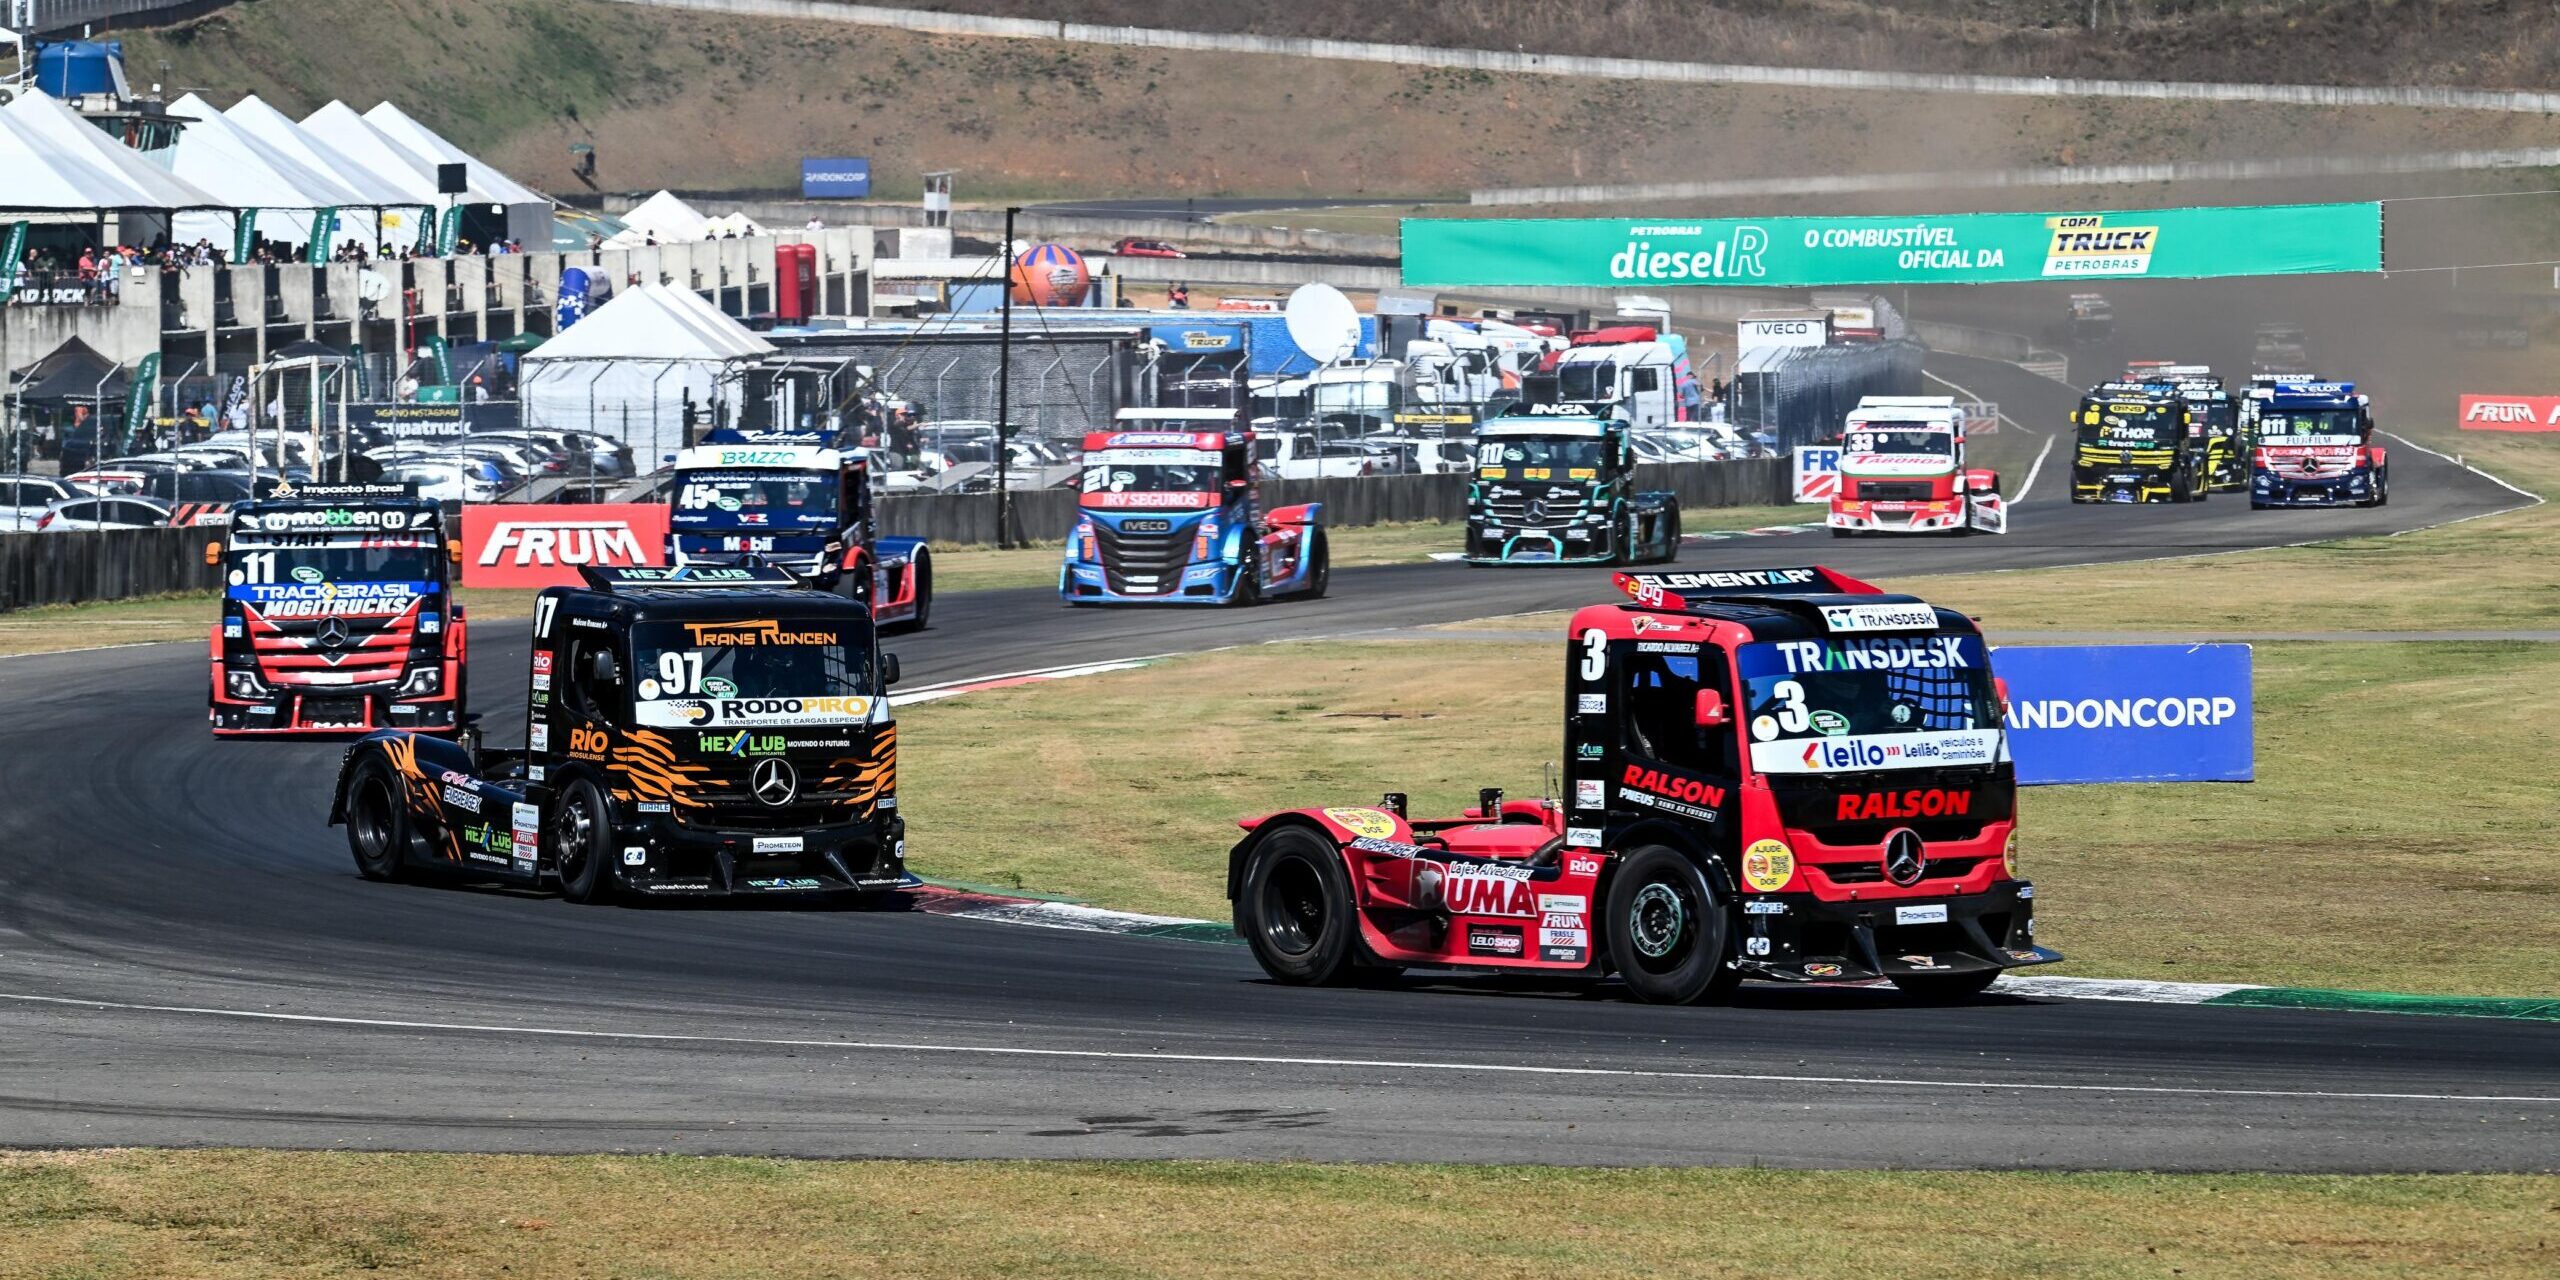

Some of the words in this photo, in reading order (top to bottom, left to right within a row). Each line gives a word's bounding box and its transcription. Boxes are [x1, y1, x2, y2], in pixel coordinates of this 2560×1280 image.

[805, 172, 866, 183] RANDONCORP
[2060, 218, 2098, 227] COPA
[1630, 226, 1702, 236] PETROBRAS
[1804, 229, 1819, 248] O
[1823, 224, 1958, 248] COMBUSTÍVEL
[2058, 231, 2151, 251] TRUCK
[1899, 249, 1971, 269] OFICIAL
[1976, 248, 2004, 267] DA
[2055, 259, 2139, 270] PETROBRAS
[1757, 324, 1807, 335] IVECO
[2466, 402, 2536, 423] FRUM
[2112, 428, 2155, 439] THOR
[1851, 433, 1874, 451] 33
[1083, 465, 1109, 493] 21
[303, 486, 363, 495] Impacto
[366, 484, 405, 493] Brasil
[291, 509, 379, 525] mobben
[1124, 521, 1168, 531] IVECO
[478, 521, 647, 567] FRUM
[723, 536, 775, 551] Mobil
[242, 552, 275, 584] 11
[252, 585, 330, 599] TRACK
[337, 583, 418, 598] BRASIL
[263, 597, 407, 617] MOGITRUCKS
[1860, 612, 1936, 627] TRANSDESK
[760, 620, 836, 645] RONCEN
[1580, 628, 1607, 682] 3
[1776, 637, 1969, 673] TRANSDESK
[659, 652, 703, 695] 97
[722, 698, 868, 719] RODOPIRO
[1773, 680, 1810, 733] 3
[787, 740, 819, 748] MOVENDO
[1822, 739, 1885, 768] leilo
[1904, 743, 1940, 758] Leilão
[1942, 747, 1986, 760] caminhões
[1623, 764, 1726, 808] RALSON
[1619, 787, 1656, 806] PNEUS
[640, 803, 670, 811] MAHLE
[1836, 790, 1971, 821] RALSON
[1362, 826, 1384, 834] DOE
[756, 841, 802, 849] PROMETEON
[1754, 844, 1782, 853] AJUDE
[1450, 861, 1478, 877] Lajes
[1479, 863, 1533, 879] Alveolares
[1569, 859, 1599, 872] RIO
[1760, 878, 1778, 886] DOE
[1542, 913, 1584, 928] FRUM
[1900, 910, 1946, 920] PROMETEON
